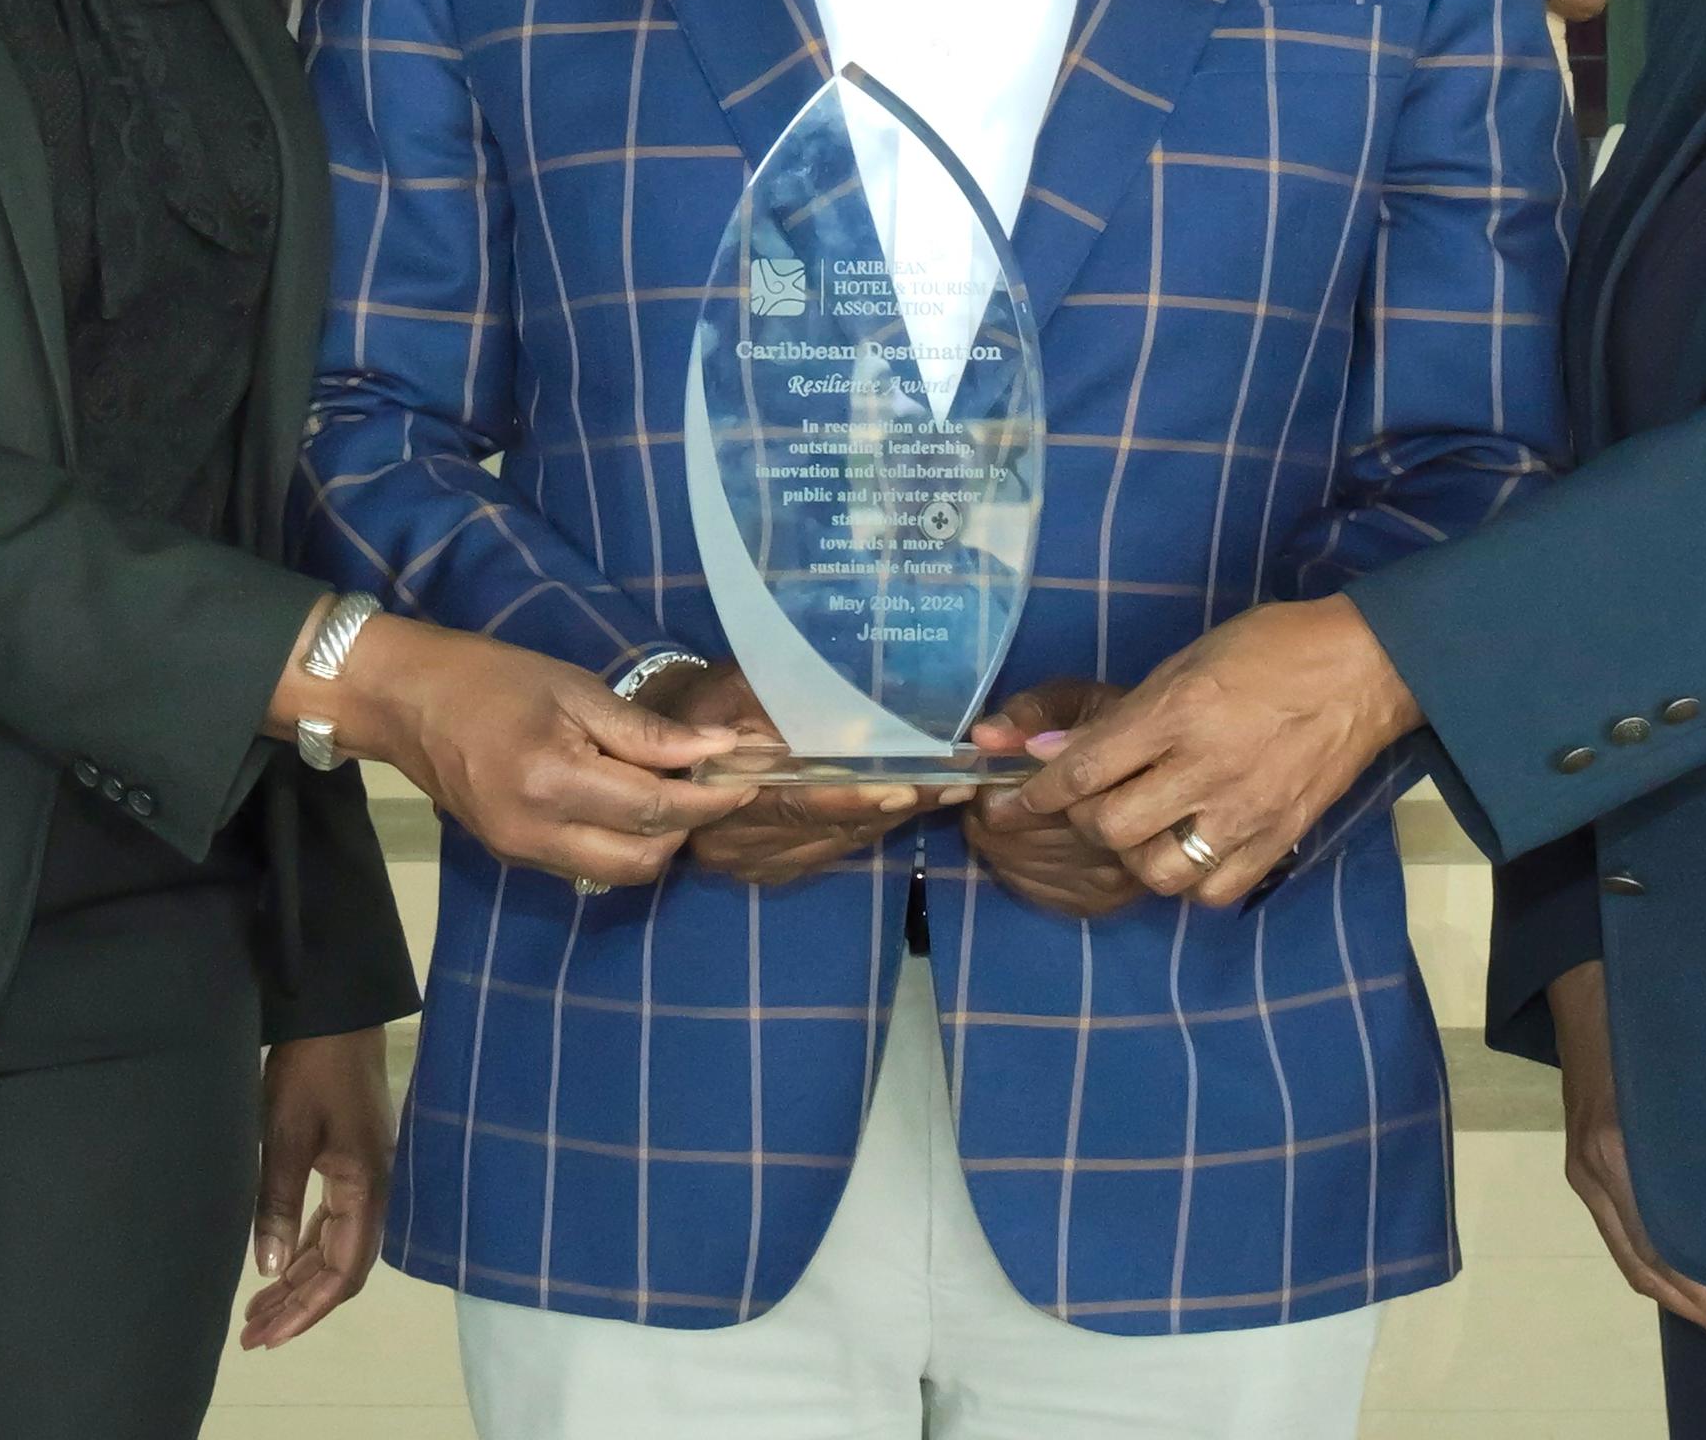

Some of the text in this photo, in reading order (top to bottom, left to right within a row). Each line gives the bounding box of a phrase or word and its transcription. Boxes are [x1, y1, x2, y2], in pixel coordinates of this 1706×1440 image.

[833, 281, 892, 296] HOTEL
[896, 282, 906, 296] &
[832, 301, 944, 316] ASSOCIATION
[735, 340, 1002, 361] Caribbean Destination
[787, 373, 959, 398] Resilience Award
[802, 419, 819, 434] In
[918, 419, 936, 434] of
[789, 439, 884, 458] outstanding
[755, 464, 1009, 482] innovation and collaboration by
[782, 488, 982, 506] public and private sector
[819, 536, 884, 551] towards
[902, 540, 944, 551] more
[903, 559, 953, 574] future
[829, 595, 866, 615] May
[920, 595, 965, 612] 2024
[856, 623, 949, 642] Jamaica
